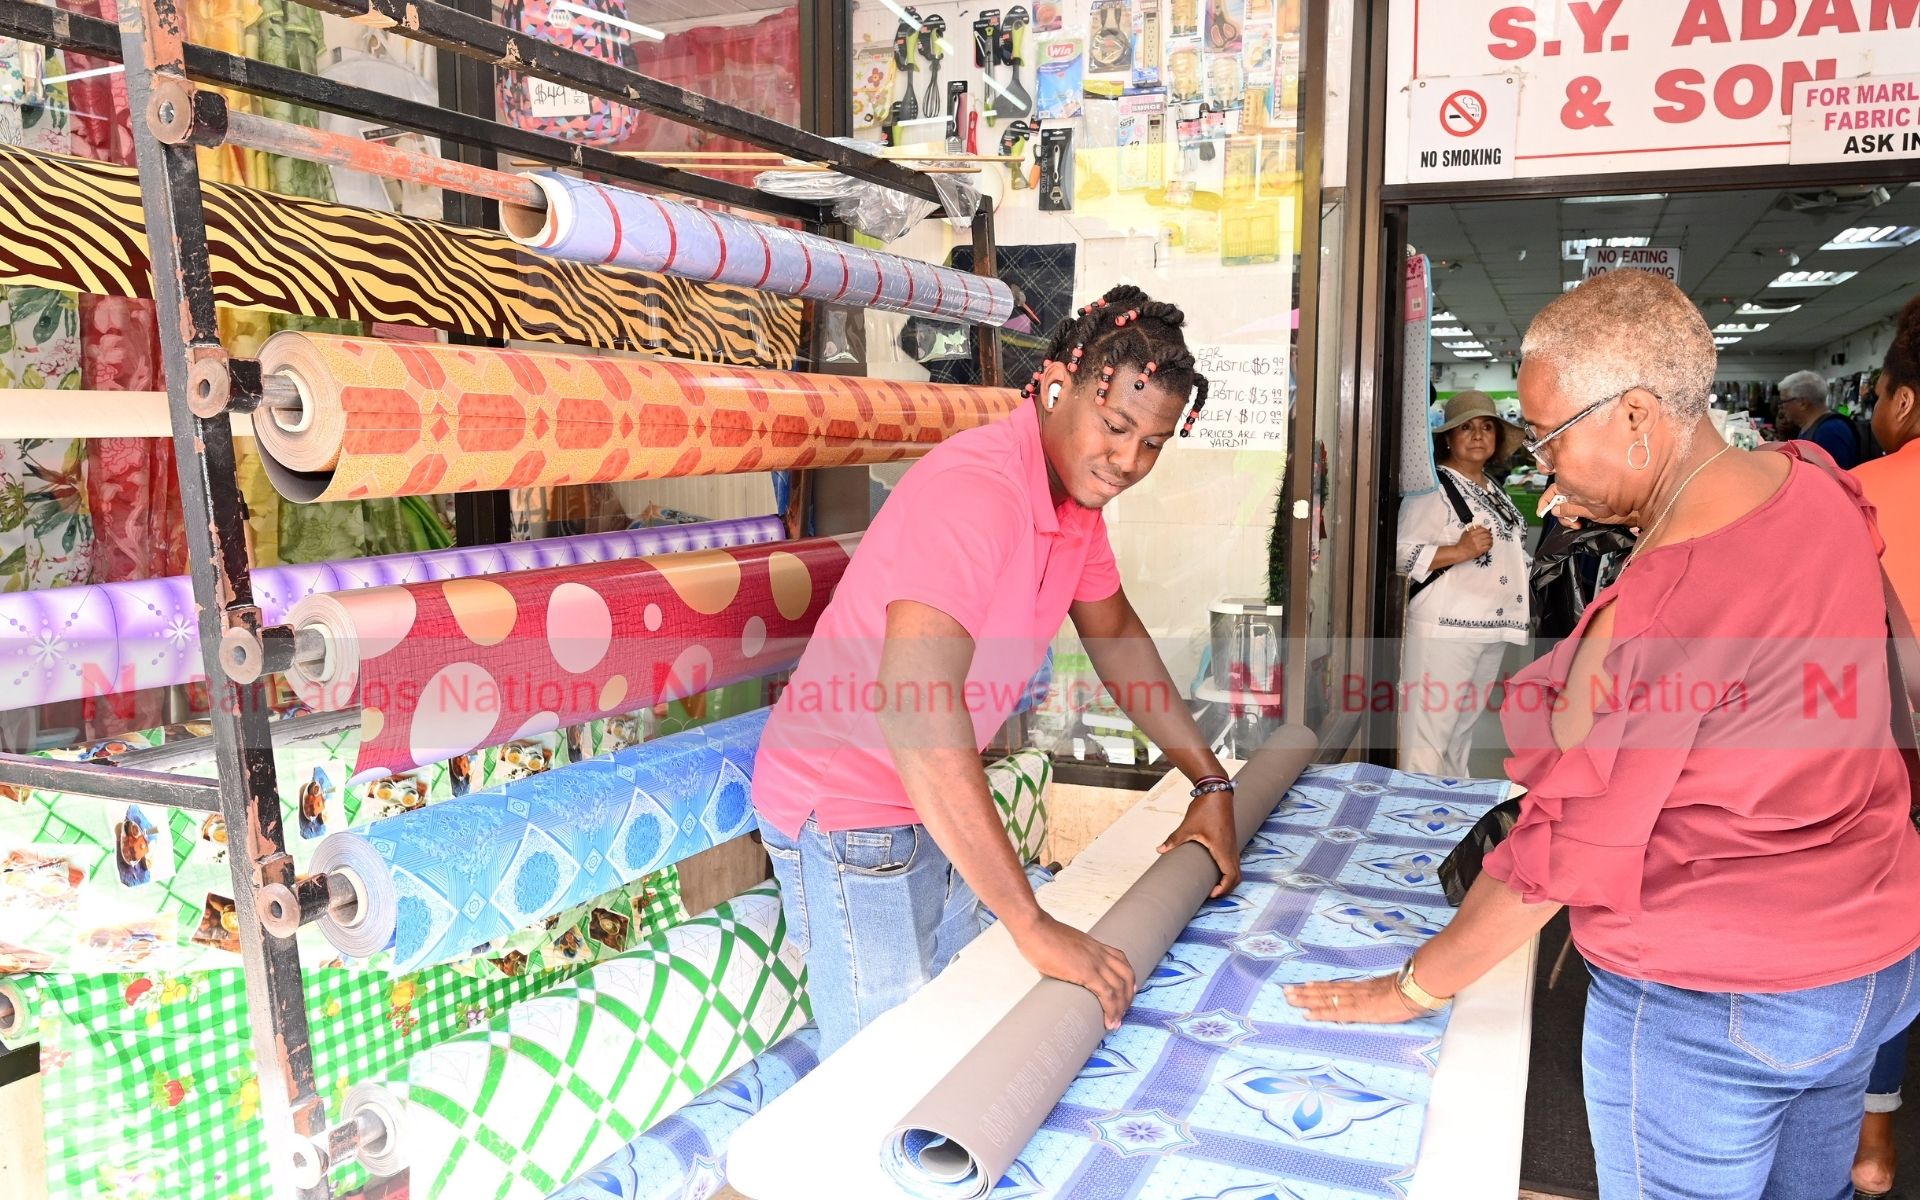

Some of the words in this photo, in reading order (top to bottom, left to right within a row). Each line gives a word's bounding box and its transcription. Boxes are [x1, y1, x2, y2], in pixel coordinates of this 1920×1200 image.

[1488, 2, 1629, 60] S.Y.
[1048, 44, 1073, 56] Win
[1560, 75, 1613, 130] &
[1654, 58, 1837, 124] SON
[1806, 86, 1850, 107] FOR
[1856, 82, 1920, 104] MARL
[1824, 107, 1911, 131] FABRIC
[1843, 133, 1895, 155] ASK
[1420, 150, 1437, 168] NO
[1442, 147, 1502, 167] SMOKING
[1597, 250, 1617, 263] NO
[1622, 250, 1668, 263] EATING
[1200, 359, 1251, 373] PLASTIC
[1199, 428, 1233, 439] PRICES
[1237, 430, 1257, 439] ARE
[1263, 431, 1281, 440] PER
